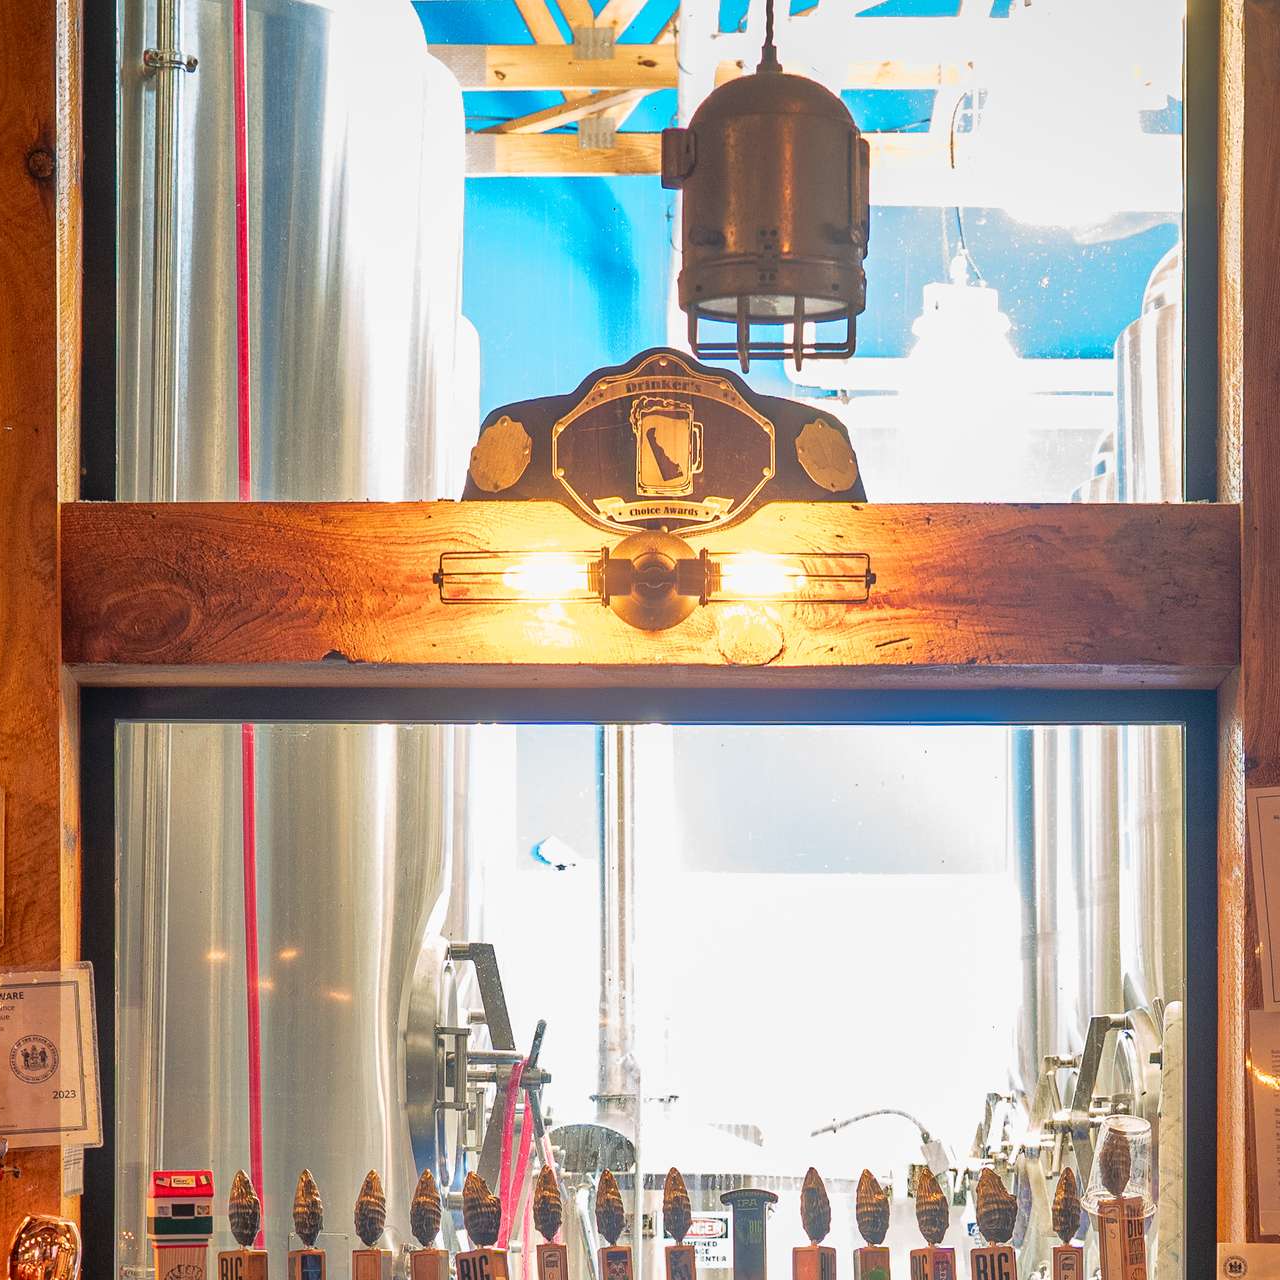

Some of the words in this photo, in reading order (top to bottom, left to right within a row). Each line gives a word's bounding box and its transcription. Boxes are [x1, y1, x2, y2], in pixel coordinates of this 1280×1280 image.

[626, 380, 702, 393] Drinker's
[630, 507, 661, 516] Choice
[663, 507, 698, 516] Awards
[52, 1090, 76, 1099] 2023
